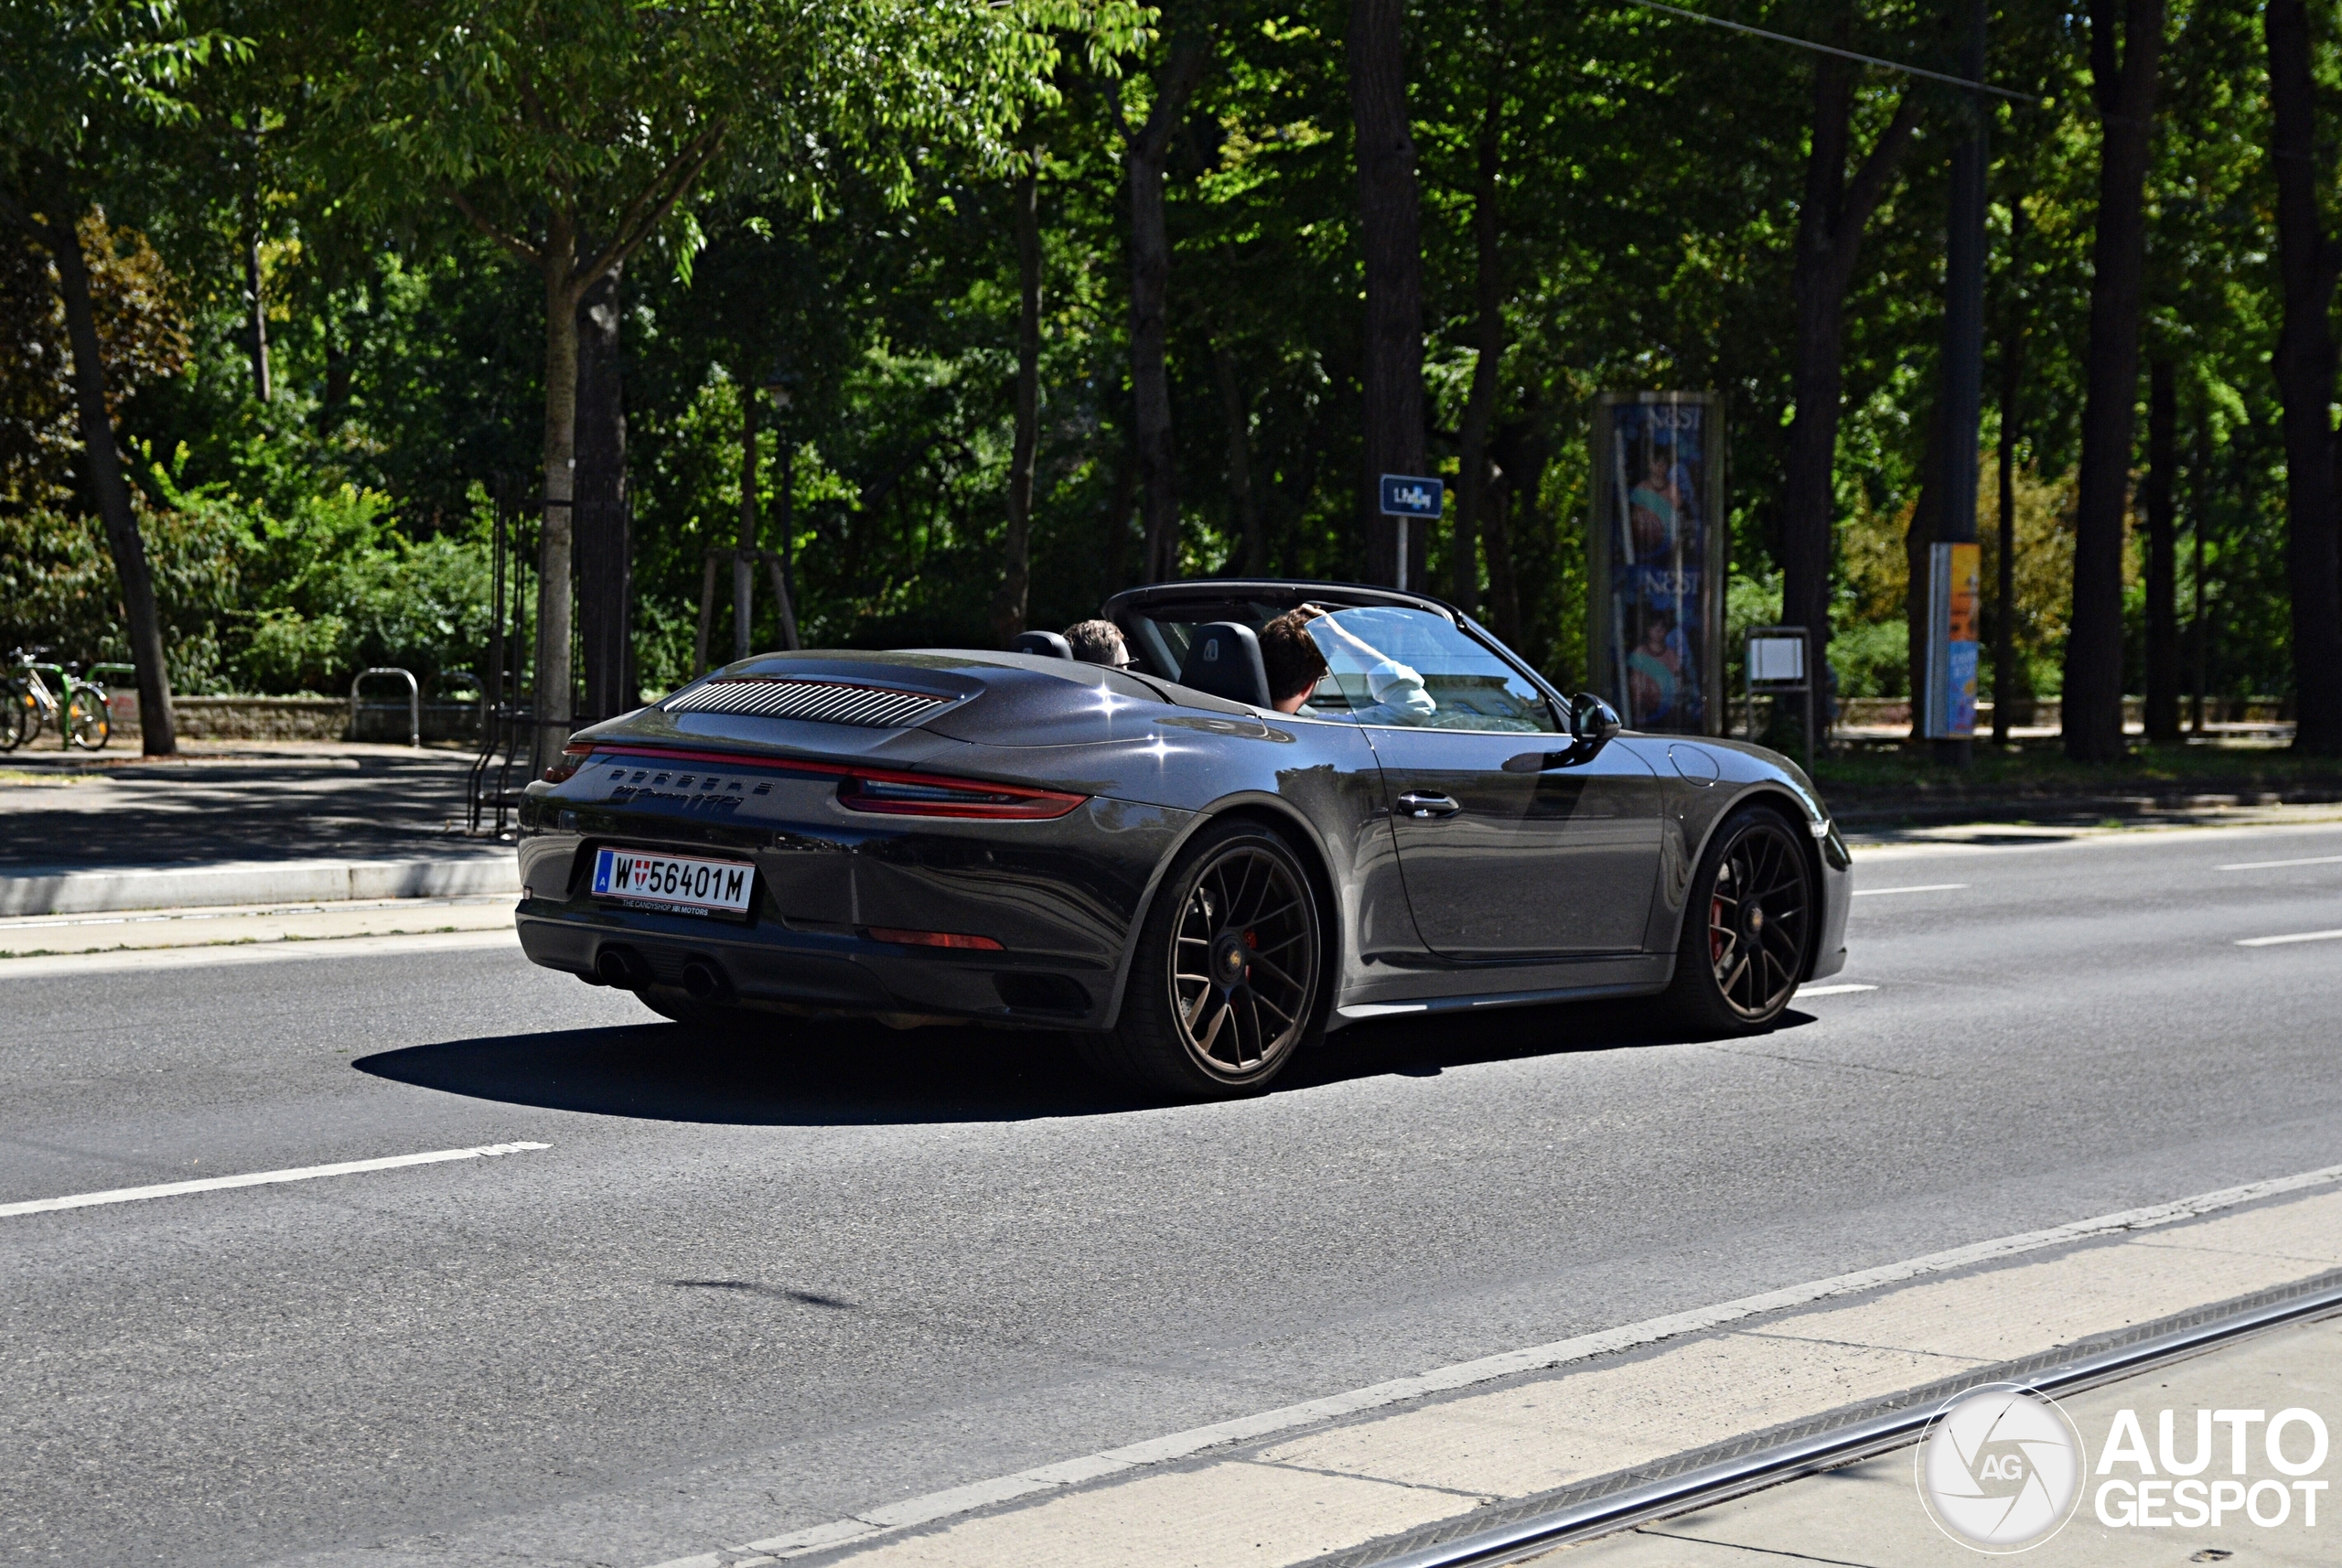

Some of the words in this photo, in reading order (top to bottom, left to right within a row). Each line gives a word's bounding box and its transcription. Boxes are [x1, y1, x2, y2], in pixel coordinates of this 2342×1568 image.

[599, 876, 606, 887] A
[616, 857, 633, 889] W
[649, 861, 745, 903] 56401M
[623, 899, 634, 908] THE
[635, 901, 671, 911] CANDYSHOP
[682, 906, 709, 917] MOTORS
